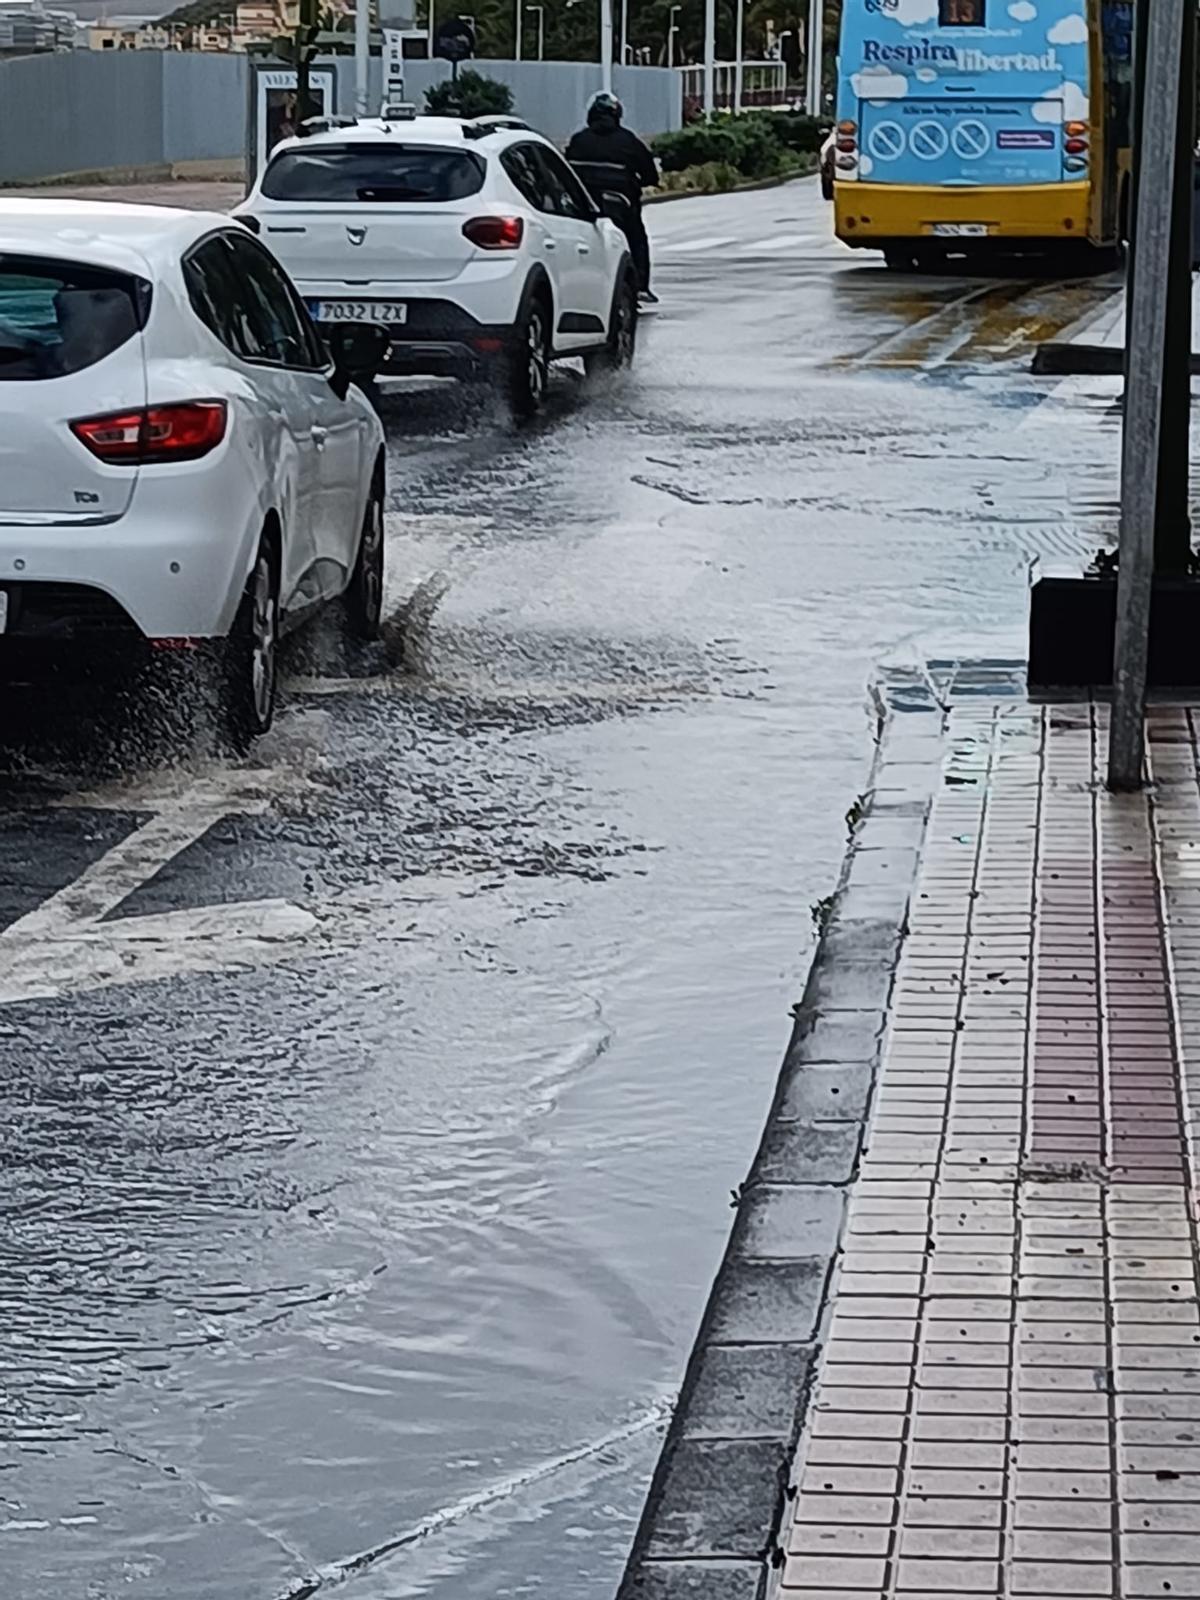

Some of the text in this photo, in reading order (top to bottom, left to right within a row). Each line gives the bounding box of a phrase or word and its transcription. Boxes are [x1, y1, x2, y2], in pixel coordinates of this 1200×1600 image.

[863, 38, 1063, 71] Respira libertad.
[323, 303, 403, 321] 7032 LZX
